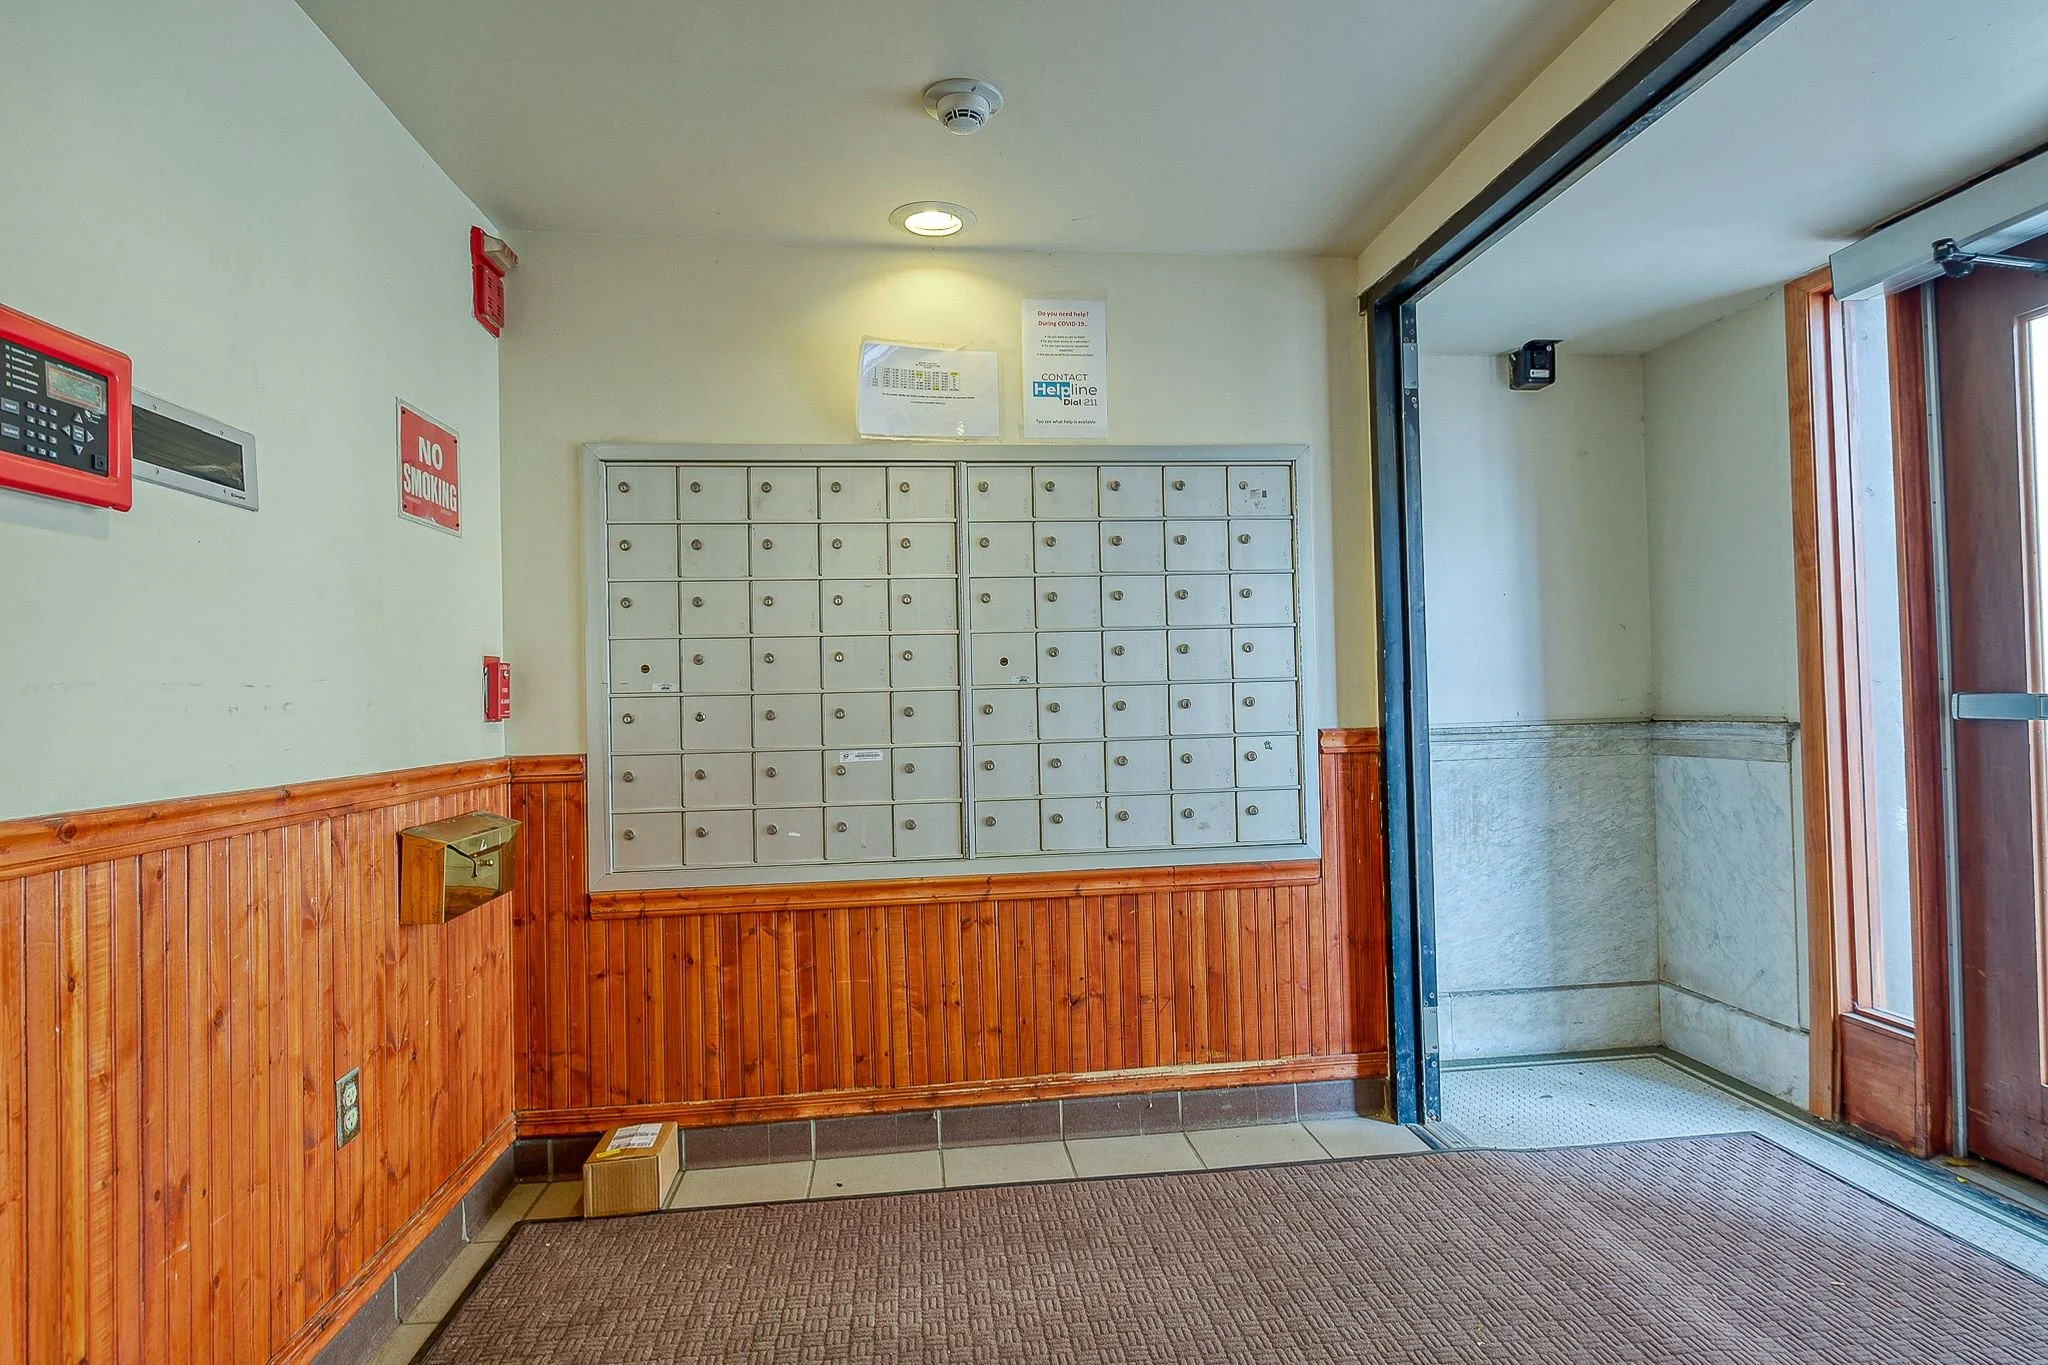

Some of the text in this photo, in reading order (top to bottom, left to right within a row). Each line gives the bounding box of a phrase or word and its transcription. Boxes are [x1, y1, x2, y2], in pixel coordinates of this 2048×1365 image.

[1042, 373, 1088, 381] CONTACT
[1034, 382, 1098, 398] Helpline
[418, 436, 442, 470] NO
[403, 462, 457, 513] SMOKING
